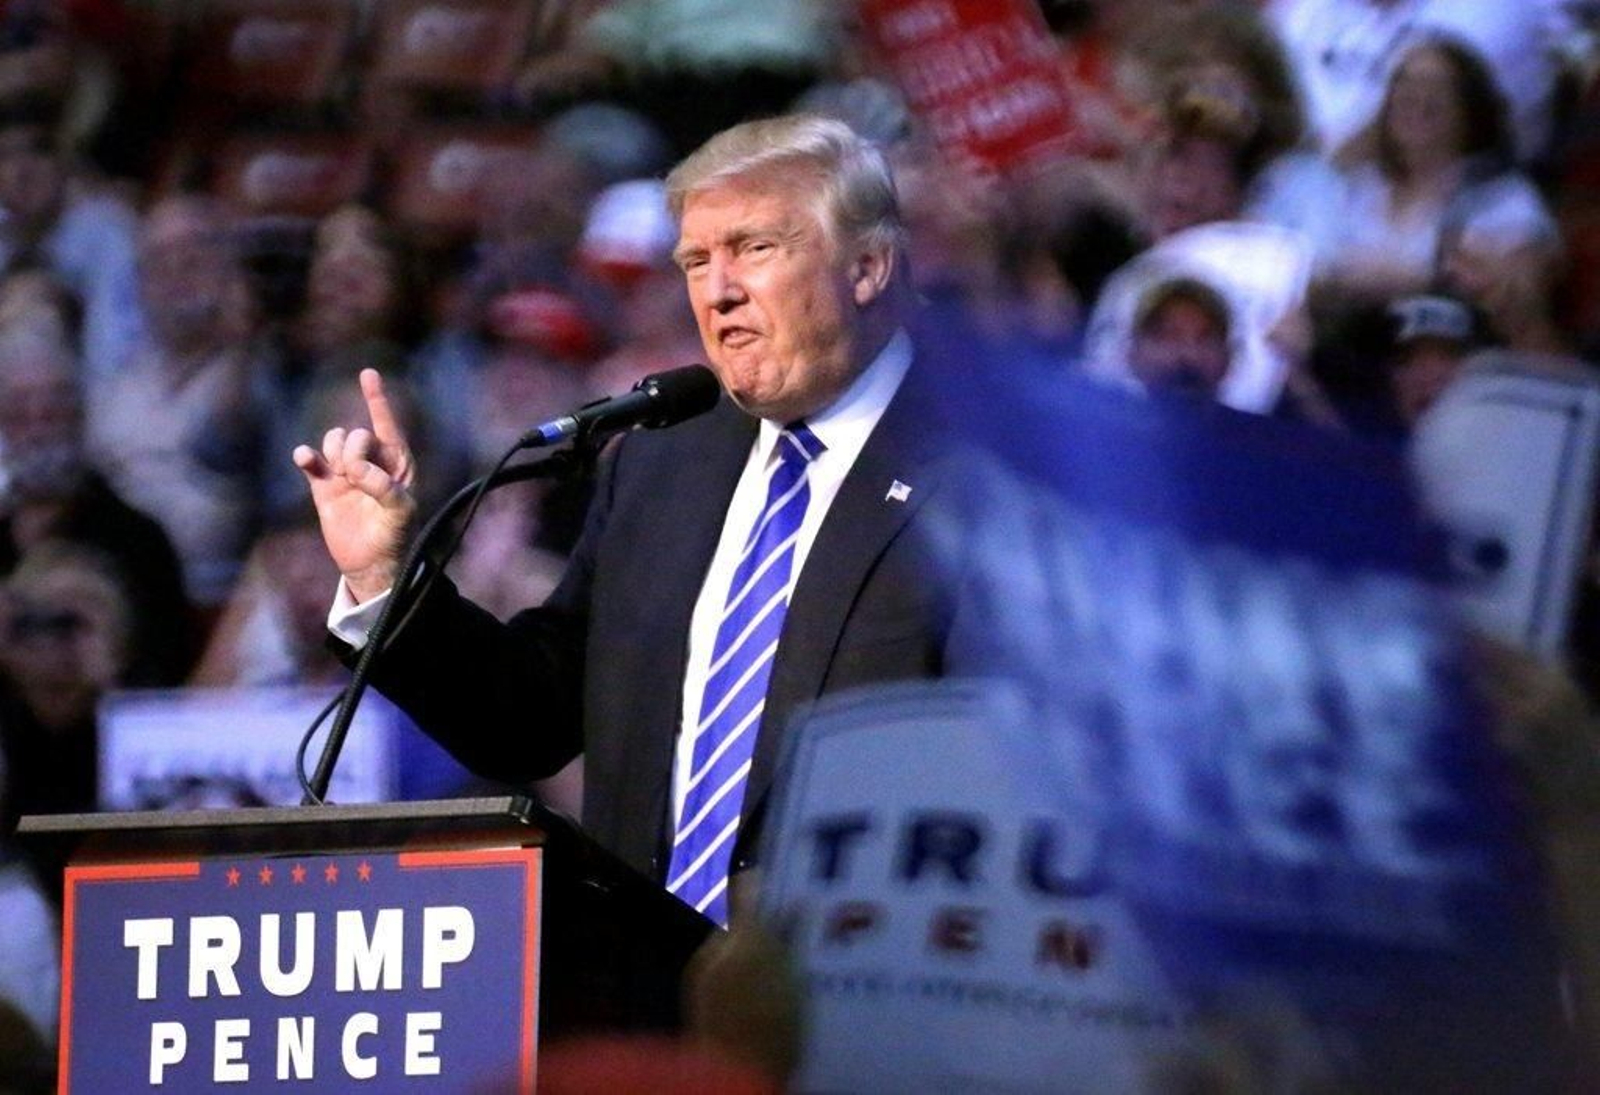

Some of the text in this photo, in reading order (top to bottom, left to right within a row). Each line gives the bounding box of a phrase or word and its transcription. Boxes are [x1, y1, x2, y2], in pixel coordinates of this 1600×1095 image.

[811, 809, 1108, 896] TRU
[124, 906, 475, 999] TRUMP
[825, 902, 1103, 972] PEN
[149, 1011, 442, 1084] PENCE
